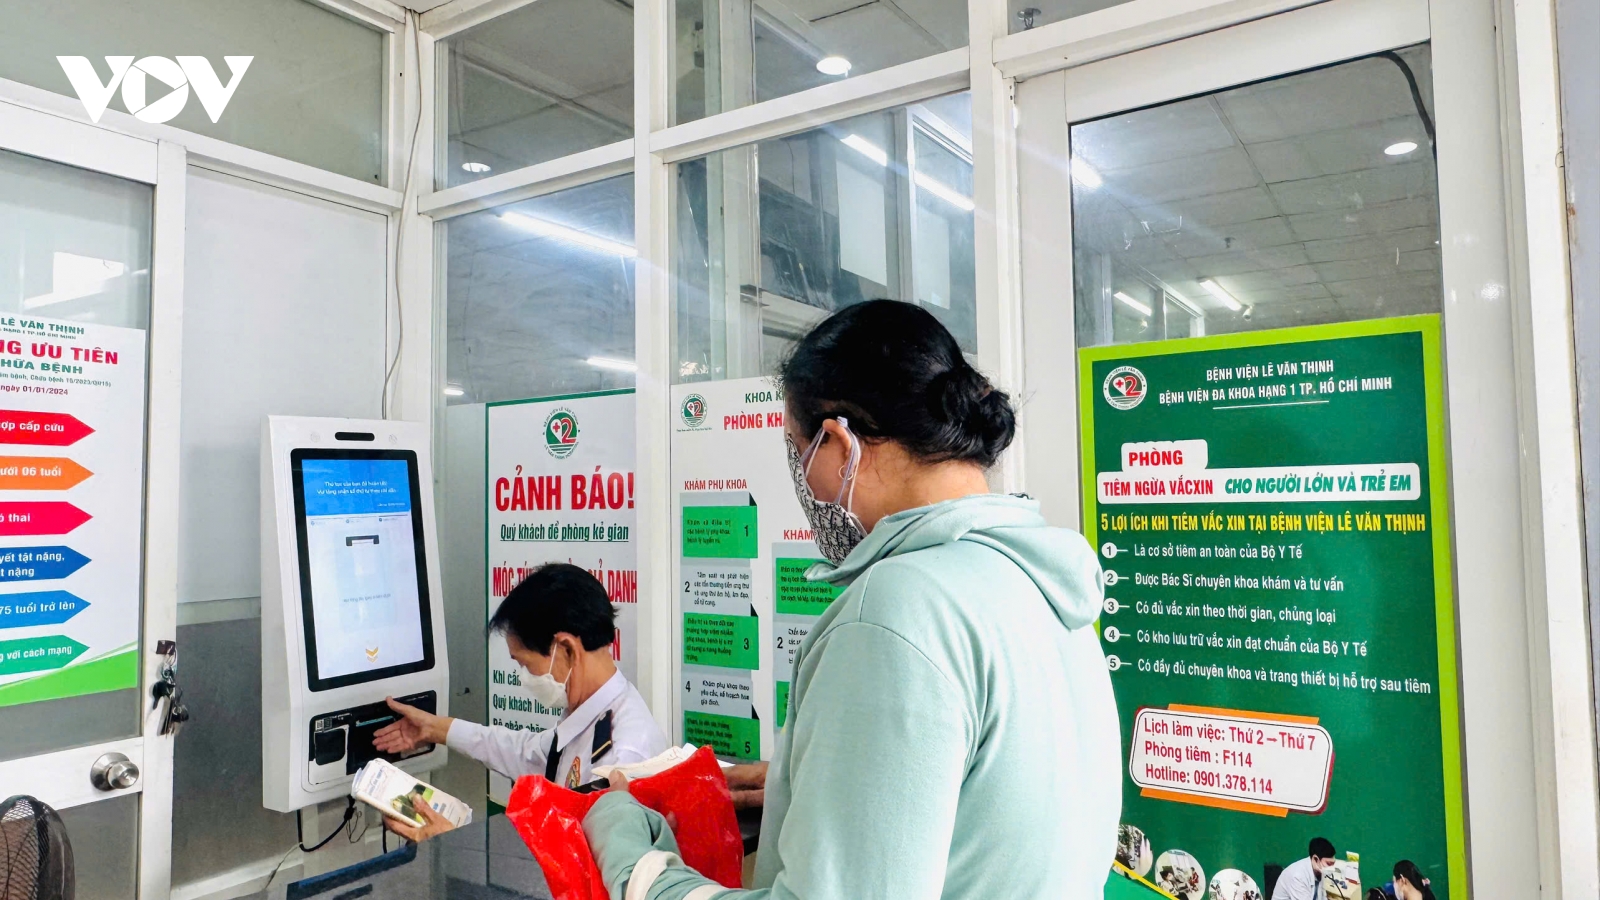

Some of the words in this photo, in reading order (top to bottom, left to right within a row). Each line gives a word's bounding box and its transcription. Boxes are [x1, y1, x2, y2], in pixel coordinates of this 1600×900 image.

[31, 341, 62, 359] ƯU
[70, 346, 119, 365] TIÊN
[40, 361, 83, 375] BỆNH
[1206, 366, 1233, 384] BỆNH
[1235, 363, 1259, 382] VIỆN
[1261, 361, 1274, 378] LÊ
[1277, 360, 1298, 376] VĂN
[1301, 359, 1335, 377] THỊNH
[22, 385, 69, 396] 01/01/2024
[744, 390, 773, 404] KHOA
[1158, 389, 1185, 407] BỆNH
[1187, 387, 1210, 405] VIỆN
[1212, 390, 1226, 401] ĐA
[1228, 386, 1256, 401] KHOA
[1258, 383, 1287, 401] HẠNG
[1289, 384, 1296, 396] 1
[1299, 382, 1317, 396] TP.
[1319, 377, 1335, 395] HỒ
[1338, 375, 1359, 393] CHÍ
[1361, 376, 1393, 392] MINH
[19, 420, 41, 432] cấp
[723, 410, 763, 431] PHÒNG
[1128, 447, 1184, 467] PHÒNG
[21, 467, 37, 477] 06
[495, 464, 562, 512] CẢNH
[571, 465, 635, 511] BÁO!
[725, 478, 747, 490] KHOA
[1103, 478, 1131, 497] TIÊM
[1134, 476, 1166, 496] NGỪA
[1169, 474, 1214, 496] VẮCXIN
[1224, 477, 1253, 494] CHO
[1255, 472, 1301, 494] NGƯỜI
[1303, 471, 1334, 493] LỚN
[1337, 470, 1357, 492] VÀ
[1361, 468, 1387, 492] TRẺ
[1389, 474, 1411, 491] EM
[8, 513, 31, 523] thai
[1100, 512, 1109, 531] 5
[1111, 513, 1128, 534] LỢI
[1130, 511, 1148, 531] ÍCH
[1151, 515, 1169, 531] KHI
[1171, 511, 1198, 531] TIÊM
[1201, 509, 1223, 531] VẮC
[1226, 514, 1245, 531] XIN
[1248, 513, 1267, 535] TẠI
[1270, 511, 1302, 535] BỆNH
[1305, 511, 1334, 535] VIỆN
[1337, 510, 1352, 531] LÊ
[1355, 511, 1381, 531] VĂN
[1385, 513, 1426, 535] THỊNH
[500, 523, 516, 541] Quý
[518, 522, 545, 540] khách
[561, 522, 590, 542] phòng
[592, 521, 605, 540] kẻ
[607, 522, 629, 542] gian
[18, 552, 33, 564] tật
[1134, 543, 1146, 557] Là
[1148, 545, 1160, 557] cơ
[1162, 542, 1173, 557] sở
[1176, 543, 1197, 558] tiêm
[1199, 548, 1211, 558] an
[1214, 544, 1237, 558] toàn
[1239, 543, 1258, 559] của
[1260, 544, 1276, 562] Bộ
[1278, 545, 1286, 559] Y
[1288, 543, 1303, 559] Tế
[608, 570, 638, 604] DANH
[684, 581, 691, 593] 2
[1135, 572, 1159, 588] Được
[1161, 572, 1180, 587] Bác
[1182, 572, 1193, 587] Sĩ
[1195, 573, 1231, 591] chuyên
[1234, 575, 1259, 589] khoa
[1262, 575, 1291, 590] khám
[1294, 575, 1307, 591] và
[1309, 577, 1321, 592] tư
[1324, 575, 1344, 592] vấn
[1135, 600, 1149, 614] Có
[1151, 600, 1164, 616] đủ
[1166, 599, 1183, 615] vắc
[1185, 603, 1200, 617] xin
[1203, 603, 1225, 618] theo
[1227, 604, 1247, 619] thời
[1250, 606, 1276, 622] gian,
[1279, 605, 1313, 626] chủng
[1316, 608, 1336, 626] loại
[23, 647, 45, 658] cách
[47, 645, 73, 657] mạng
[743, 637, 750, 651] 3
[777, 636, 784, 649] 2
[1136, 629, 1150, 643] Có
[1152, 630, 1170, 645] kho
[1172, 631, 1187, 646] lưu
[1189, 633, 1204, 647] trữ
[1206, 631, 1223, 648] vắc
[1226, 634, 1242, 649] xin
[1244, 636, 1262, 652] đạt
[1264, 634, 1297, 653] chuẩn
[1300, 637, 1320, 655] của
[1322, 640, 1339, 658] Bộ
[1341, 641, 1349, 656] Y
[1352, 640, 1368, 657] Tế
[1137, 658, 1151, 672] Có
[1153, 658, 1170, 676] đầy
[1173, 659, 1186, 675] đủ
[1188, 662, 1224, 680] chuyên
[1227, 665, 1252, 680] khoa
[1254, 667, 1267, 681] và
[1269, 668, 1298, 687] trang
[1301, 669, 1326, 686] thiết
[1329, 672, 1340, 690] bị
[1343, 671, 1358, 689] hỗ
[1360, 675, 1377, 693] trợ
[1380, 678, 1401, 692] sau
[1404, 677, 1431, 694] tiêm
[685, 680, 692, 693] 4
[493, 693, 507, 712] Quý
[508, 695, 533, 713] khách
[1144, 717, 1169, 739] Lịch
[1172, 719, 1194, 738] làm
[1197, 724, 1226, 744] việc:
[1229, 726, 1254, 745] Thứ
[1256, 729, 1265, 746] 2
[1279, 731, 1306, 750] Thứ
[1307, 735, 1316, 751] 7
[744, 741, 751, 754] 5
[1144, 740, 1182, 763] Phòng
[1186, 744, 1212, 763] tiêm
[1222, 749, 1253, 768] F114
[1145, 763, 1190, 784] Hotline:
[1193, 769, 1273, 795] 0901.378.114
